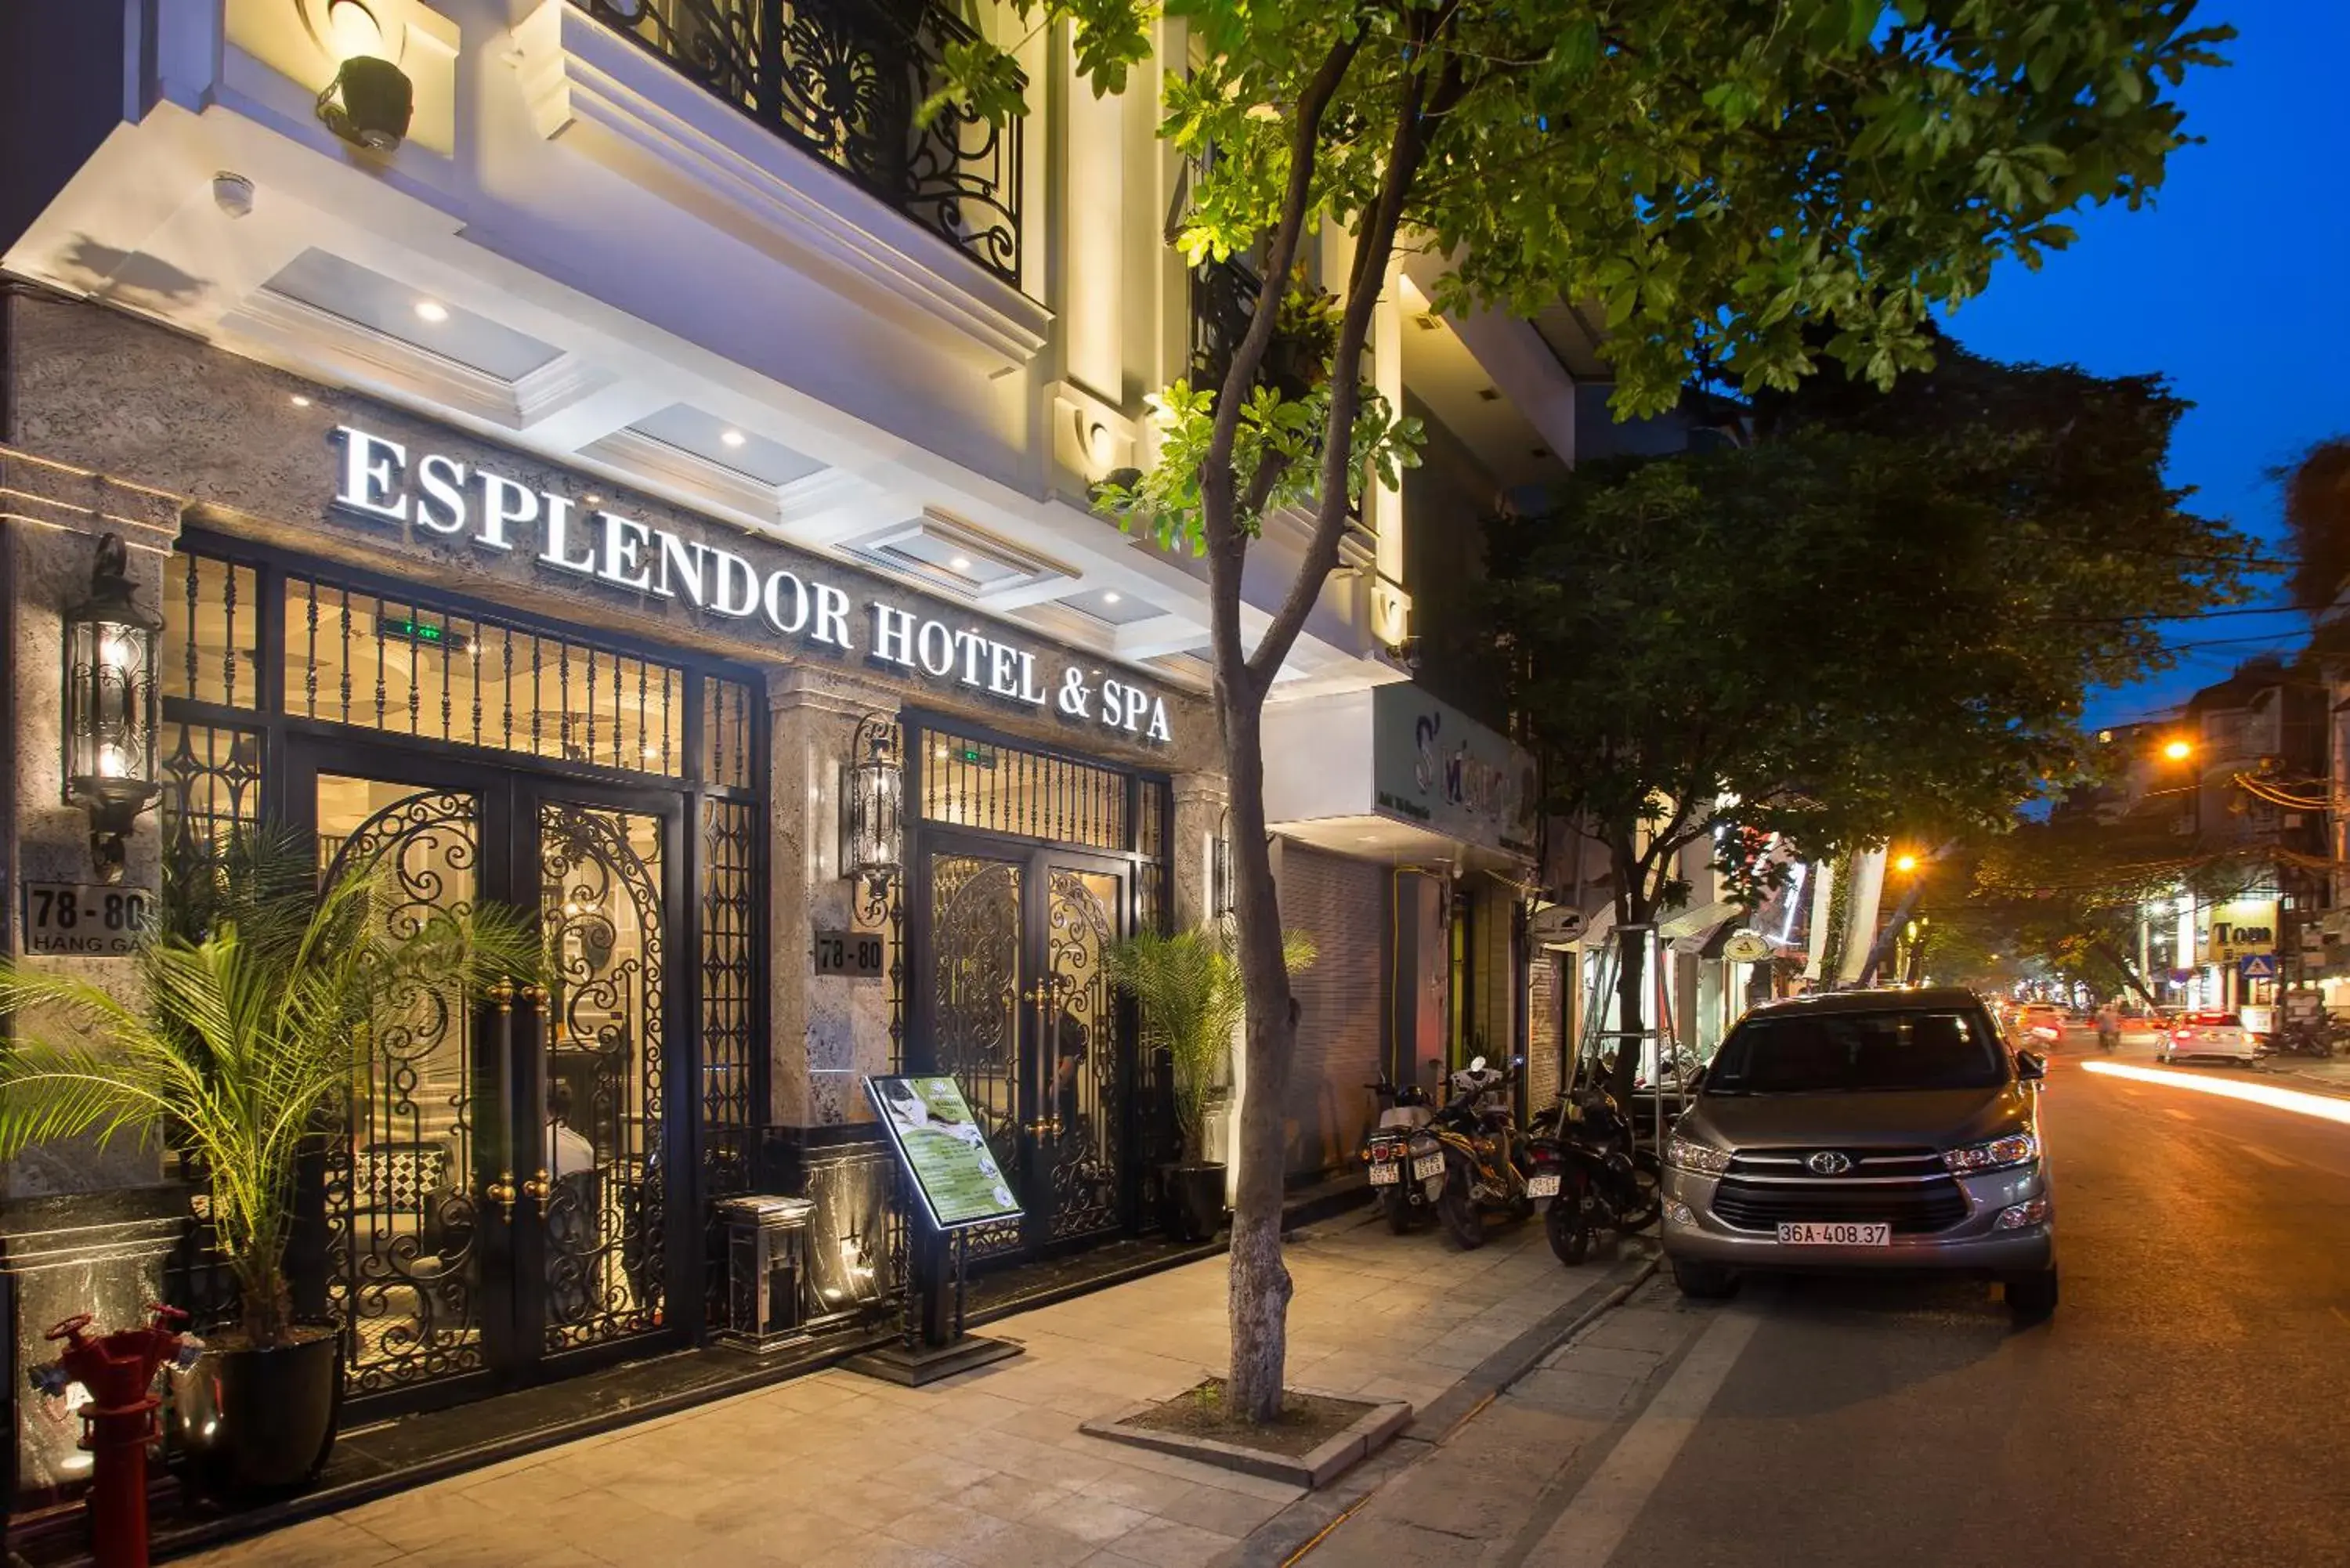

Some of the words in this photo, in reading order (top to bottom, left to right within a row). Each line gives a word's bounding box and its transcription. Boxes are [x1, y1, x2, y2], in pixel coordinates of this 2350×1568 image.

[337, 425, 854, 649] ESPLENDOR
[872, 601, 1046, 705] HOTEL
[1058, 666, 1090, 719] &
[1101, 678, 1172, 742] SPA
[33, 890, 78, 929] 78
[104, 894, 144, 931] 80
[33, 935, 103, 952] HANG
[819, 939, 844, 969] 78
[859, 941, 880, 970] 80
[1780, 1224, 1886, 1244] 36A-408.37
